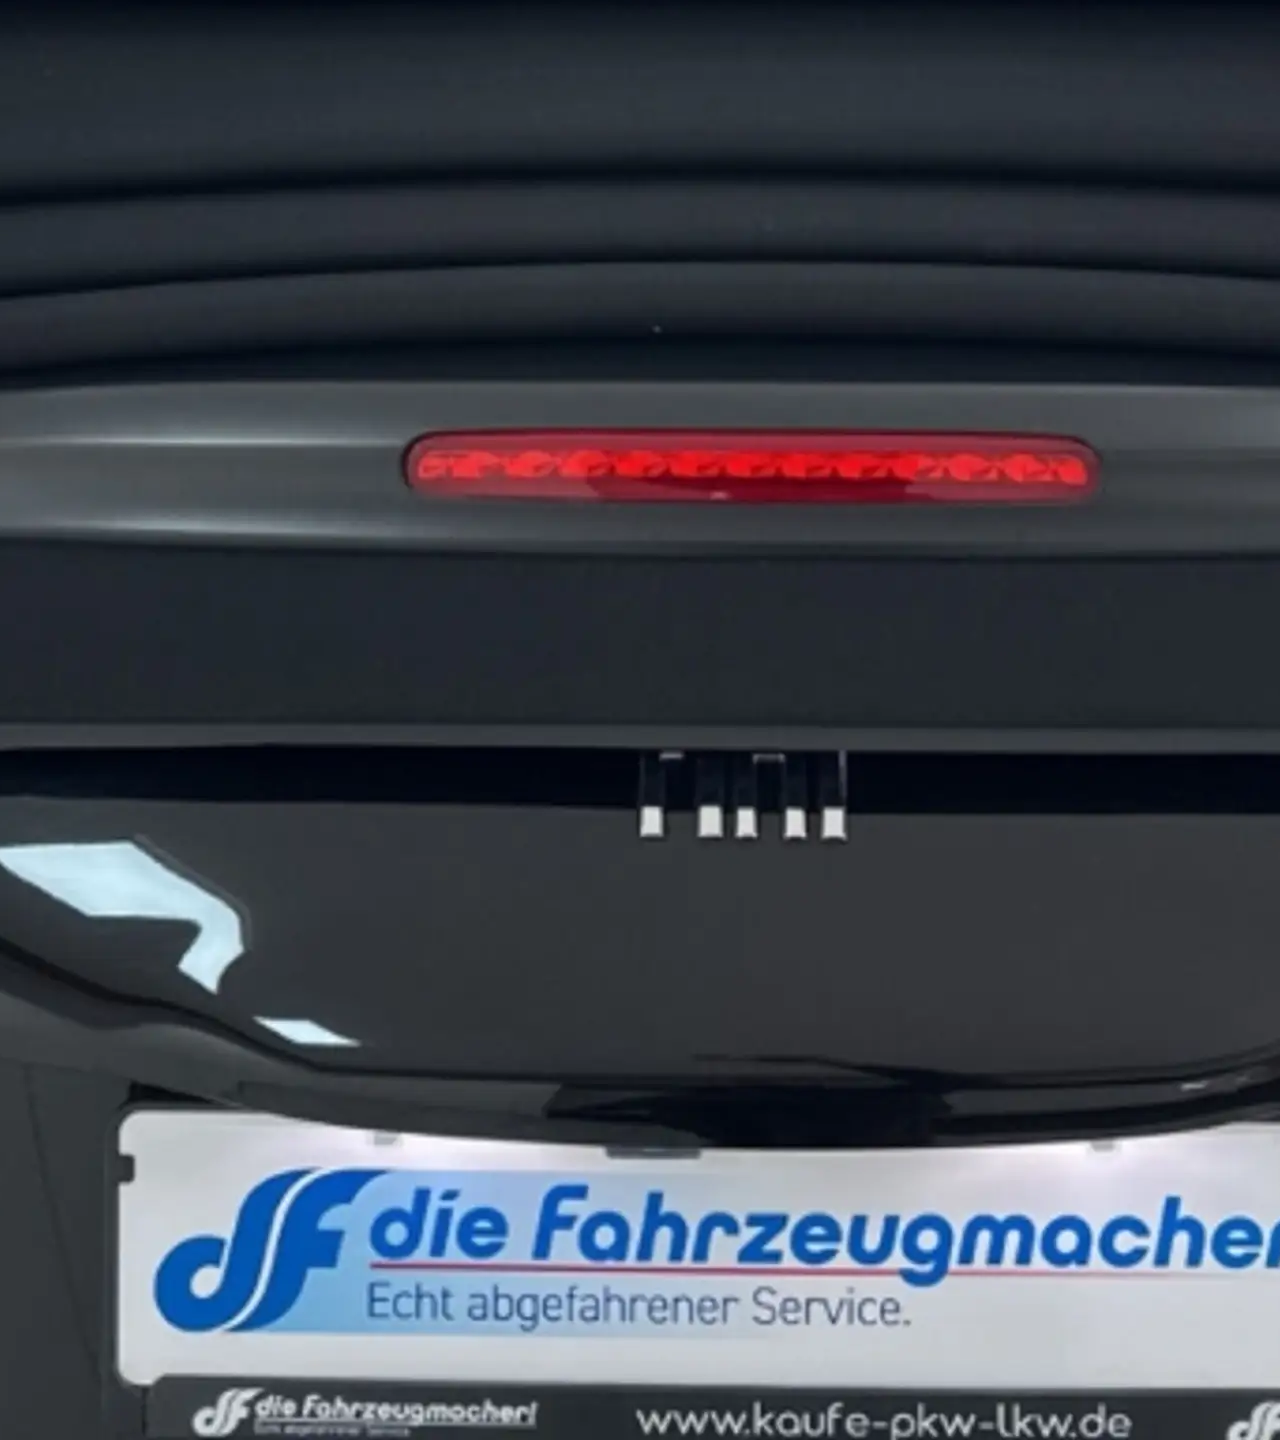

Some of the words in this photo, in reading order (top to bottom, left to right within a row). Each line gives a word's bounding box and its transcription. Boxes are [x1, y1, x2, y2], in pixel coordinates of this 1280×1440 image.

[369, 1186, 508, 1260] die
[367, 1281, 453, 1321] Echt
[466, 1283, 740, 1332] abgefahrener
[751, 1285, 913, 1327] Service.
[635, 1400, 1133, 1440] www.kaufe-pkw-lkw.de
